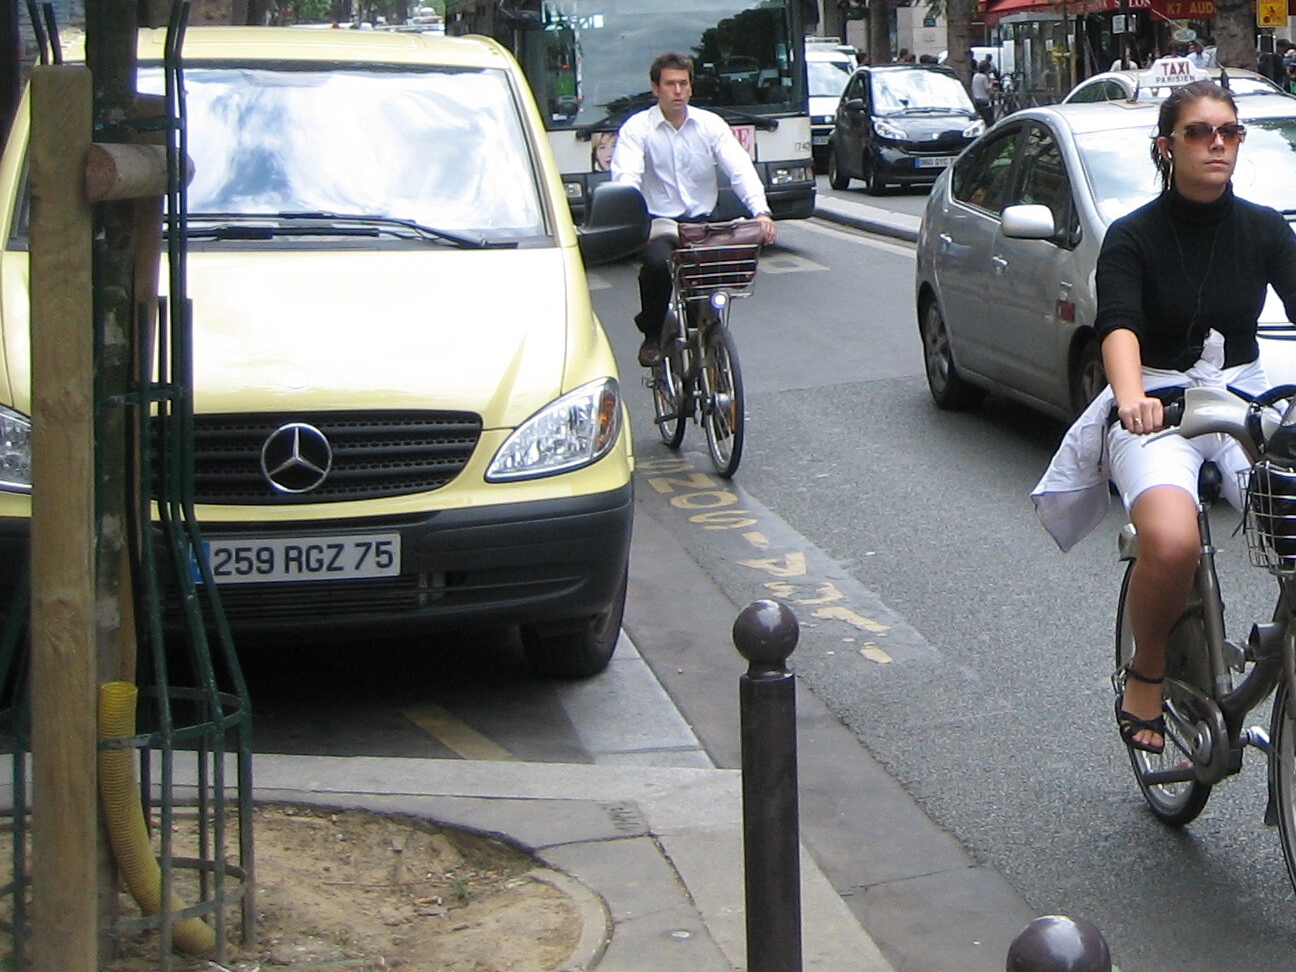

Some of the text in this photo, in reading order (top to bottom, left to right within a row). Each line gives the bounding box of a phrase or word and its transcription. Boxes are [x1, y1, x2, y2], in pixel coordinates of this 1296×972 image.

[1189, 1, 1217, 15] AUD
[1161, 62, 1190, 76] TAXI
[1155, 75, 1196, 84] PARISIEN
[213, 540, 395, 577] 259 RGZ 75
